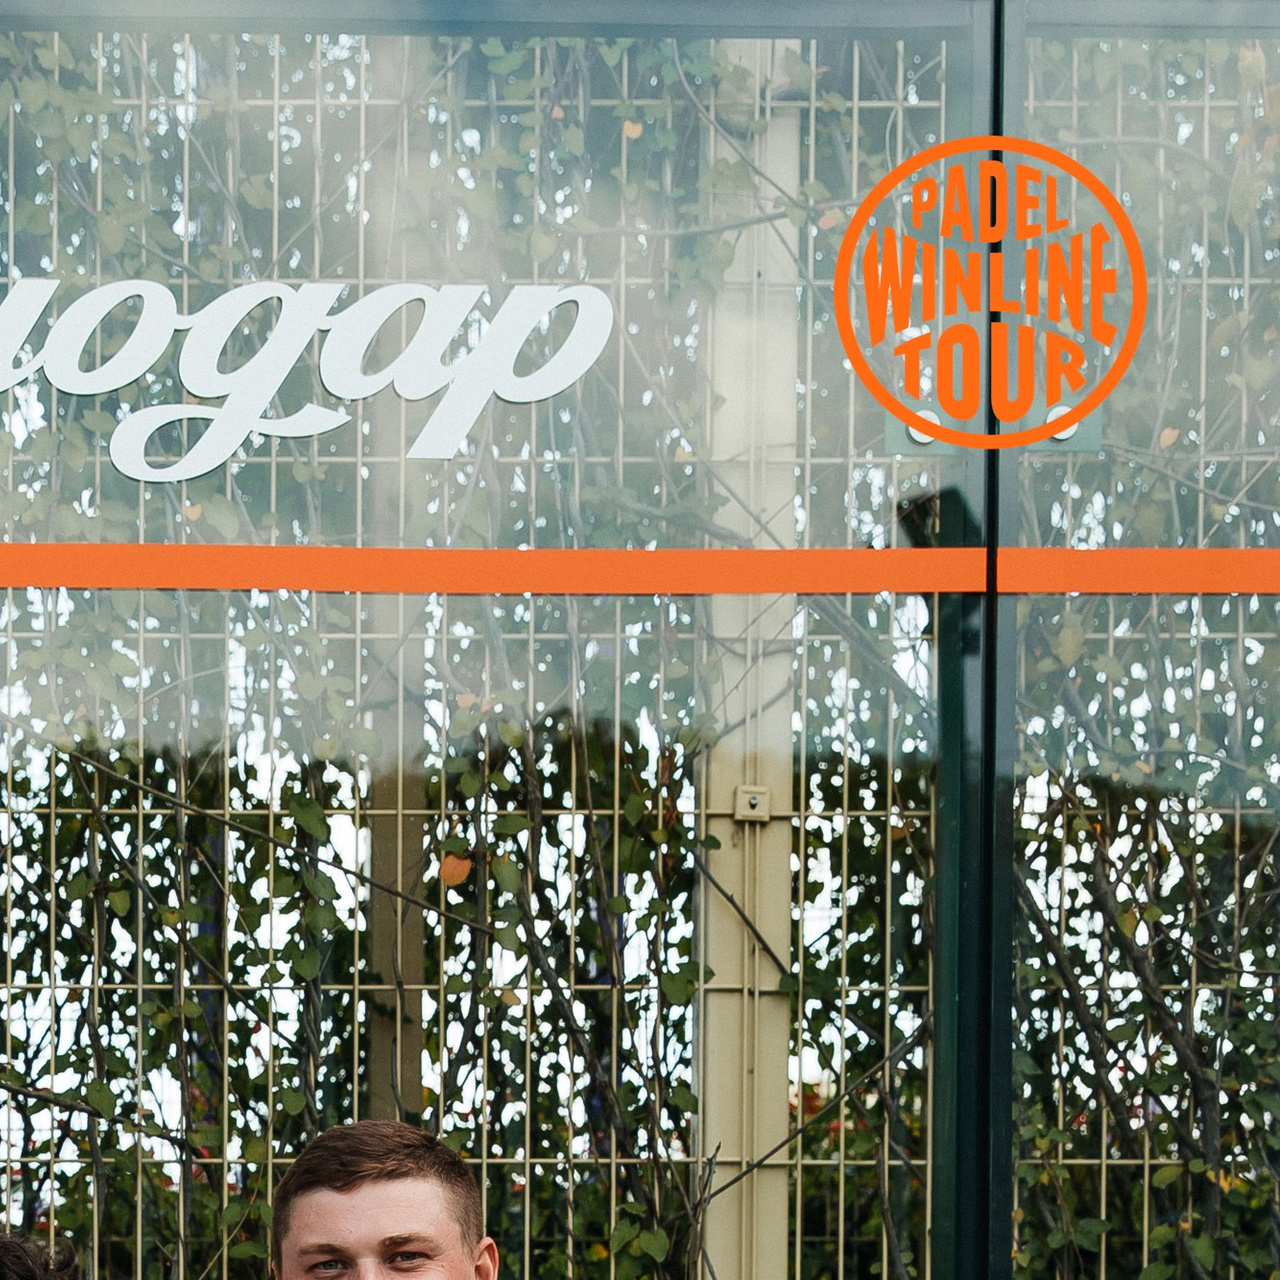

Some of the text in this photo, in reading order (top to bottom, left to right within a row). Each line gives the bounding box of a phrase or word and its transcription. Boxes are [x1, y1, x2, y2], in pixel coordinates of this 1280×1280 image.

[911, 159, 1070, 243] PADEL
[862, 221, 1118, 348] WINLINE
[893, 321, 1087, 423] TOUR
